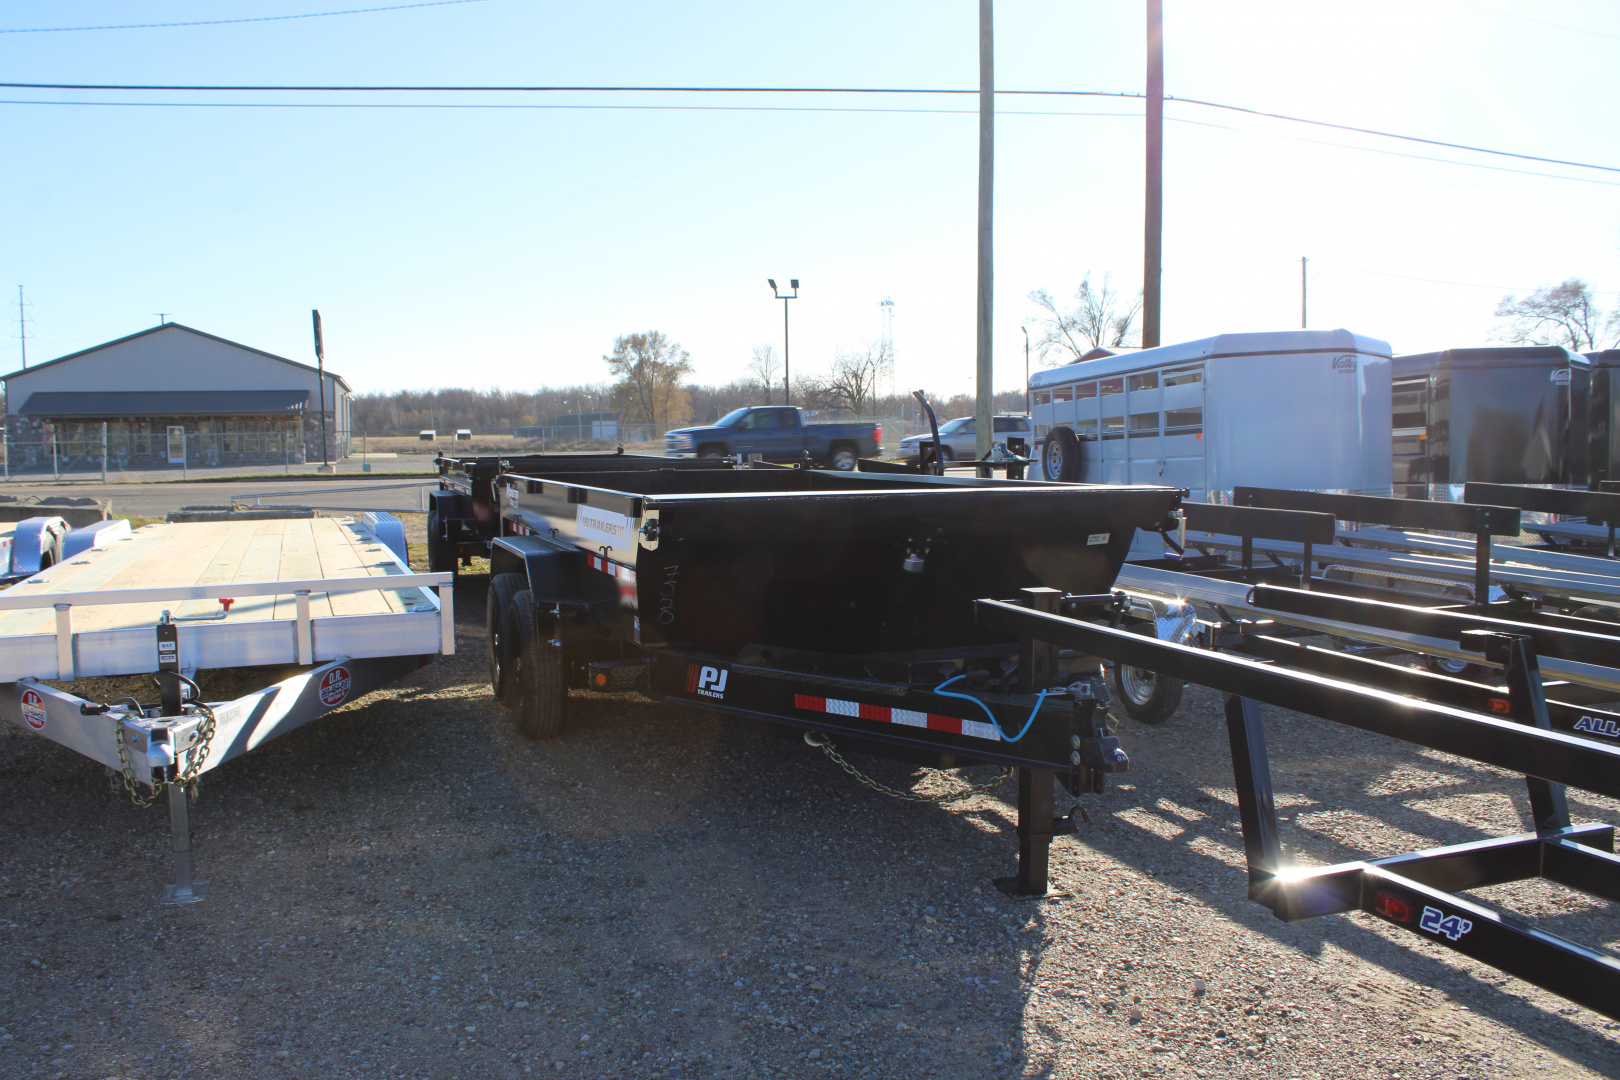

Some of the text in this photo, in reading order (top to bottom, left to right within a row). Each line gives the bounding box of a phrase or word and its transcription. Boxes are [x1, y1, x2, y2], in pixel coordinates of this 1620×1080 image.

[698, 666, 728, 692] PJ
[697, 689, 725, 699] TRAILERS
[1419, 905, 1473, 942] 24'
